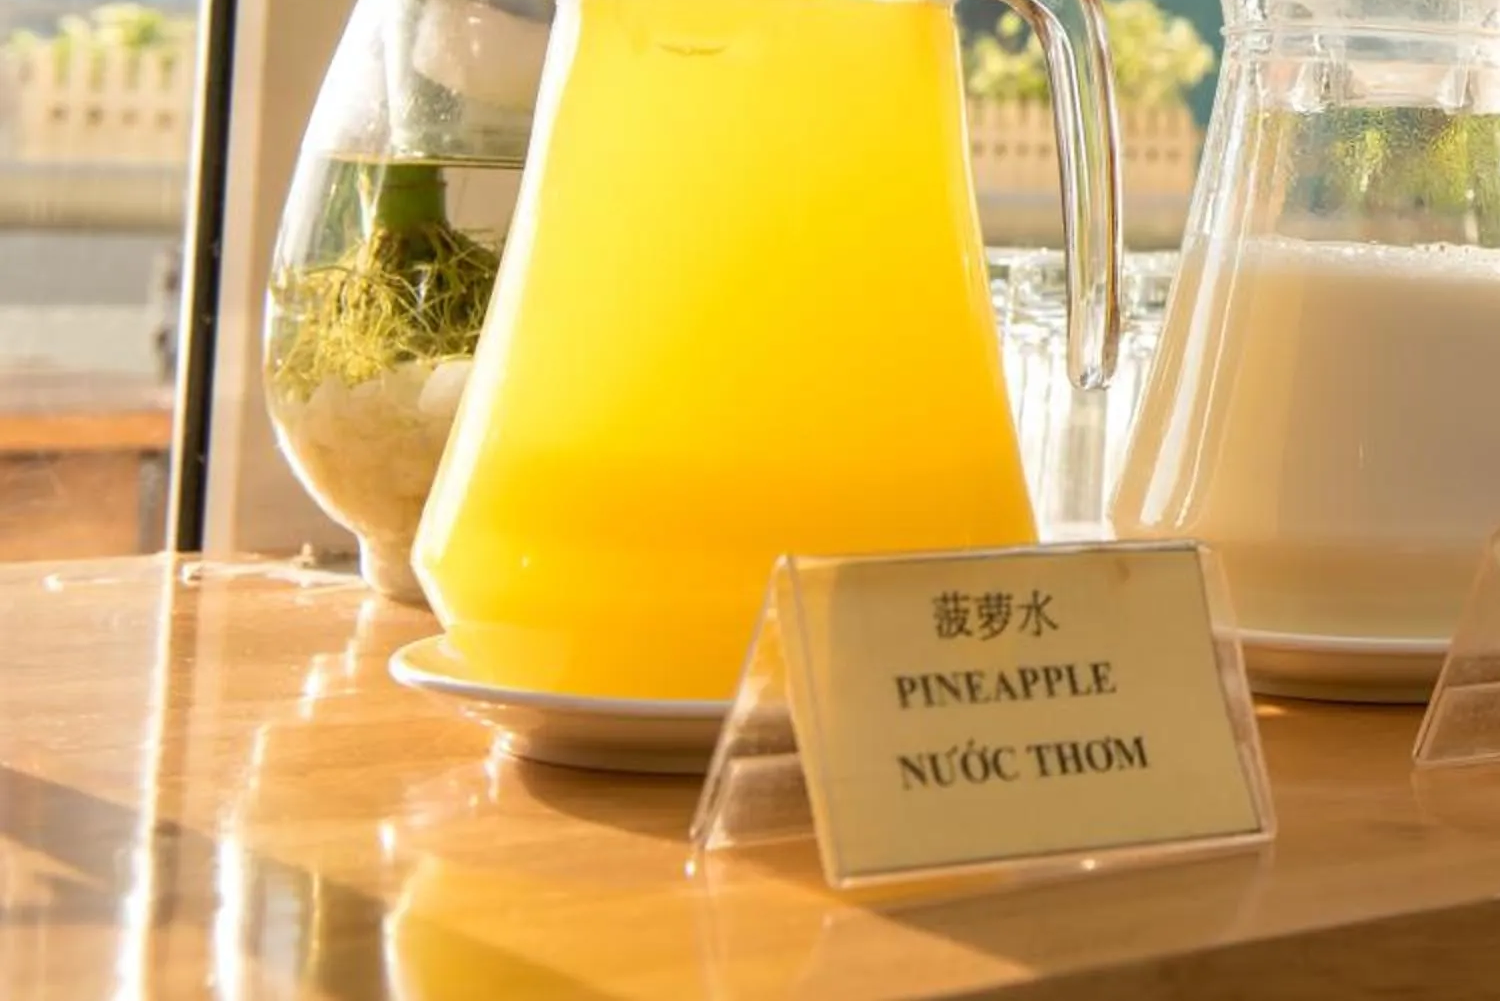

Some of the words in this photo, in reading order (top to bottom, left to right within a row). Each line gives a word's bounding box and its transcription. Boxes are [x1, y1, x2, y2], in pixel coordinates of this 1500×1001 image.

[932, 590, 1059, 641] 菠萝水
[896, 662, 1117, 709] PINEAPPLE
[897, 738, 1020, 791] NƯỚC
[1025, 735, 1149, 779] THƠM
